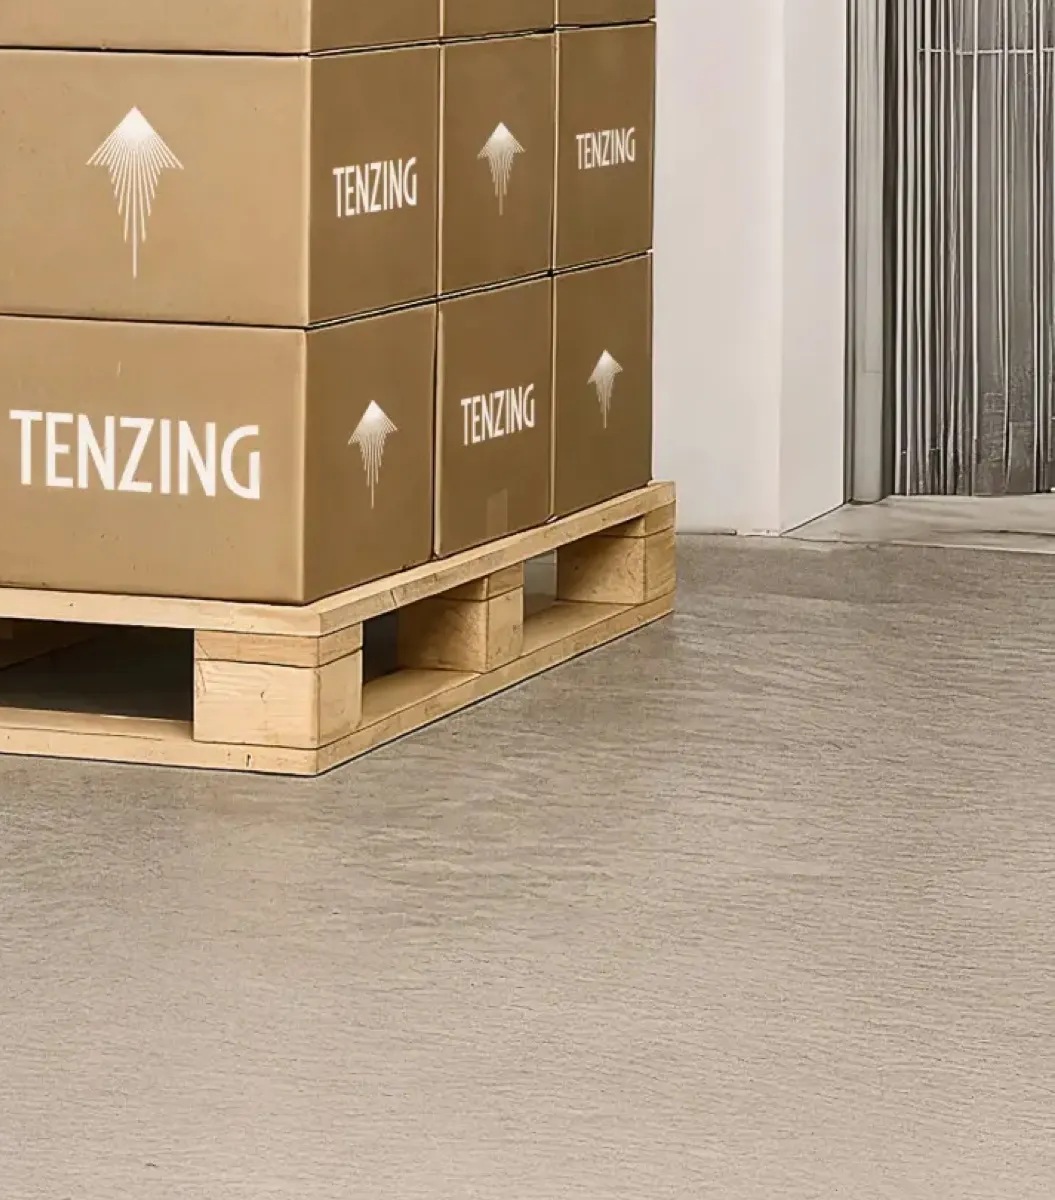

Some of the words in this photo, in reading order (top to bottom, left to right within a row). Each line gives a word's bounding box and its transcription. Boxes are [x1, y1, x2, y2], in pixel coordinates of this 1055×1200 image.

[575, 126, 635, 170] TENZING
[332, 156, 417, 218] TENZING
[460, 383, 535, 446] TENZING
[9, 409, 261, 500] TENZING
